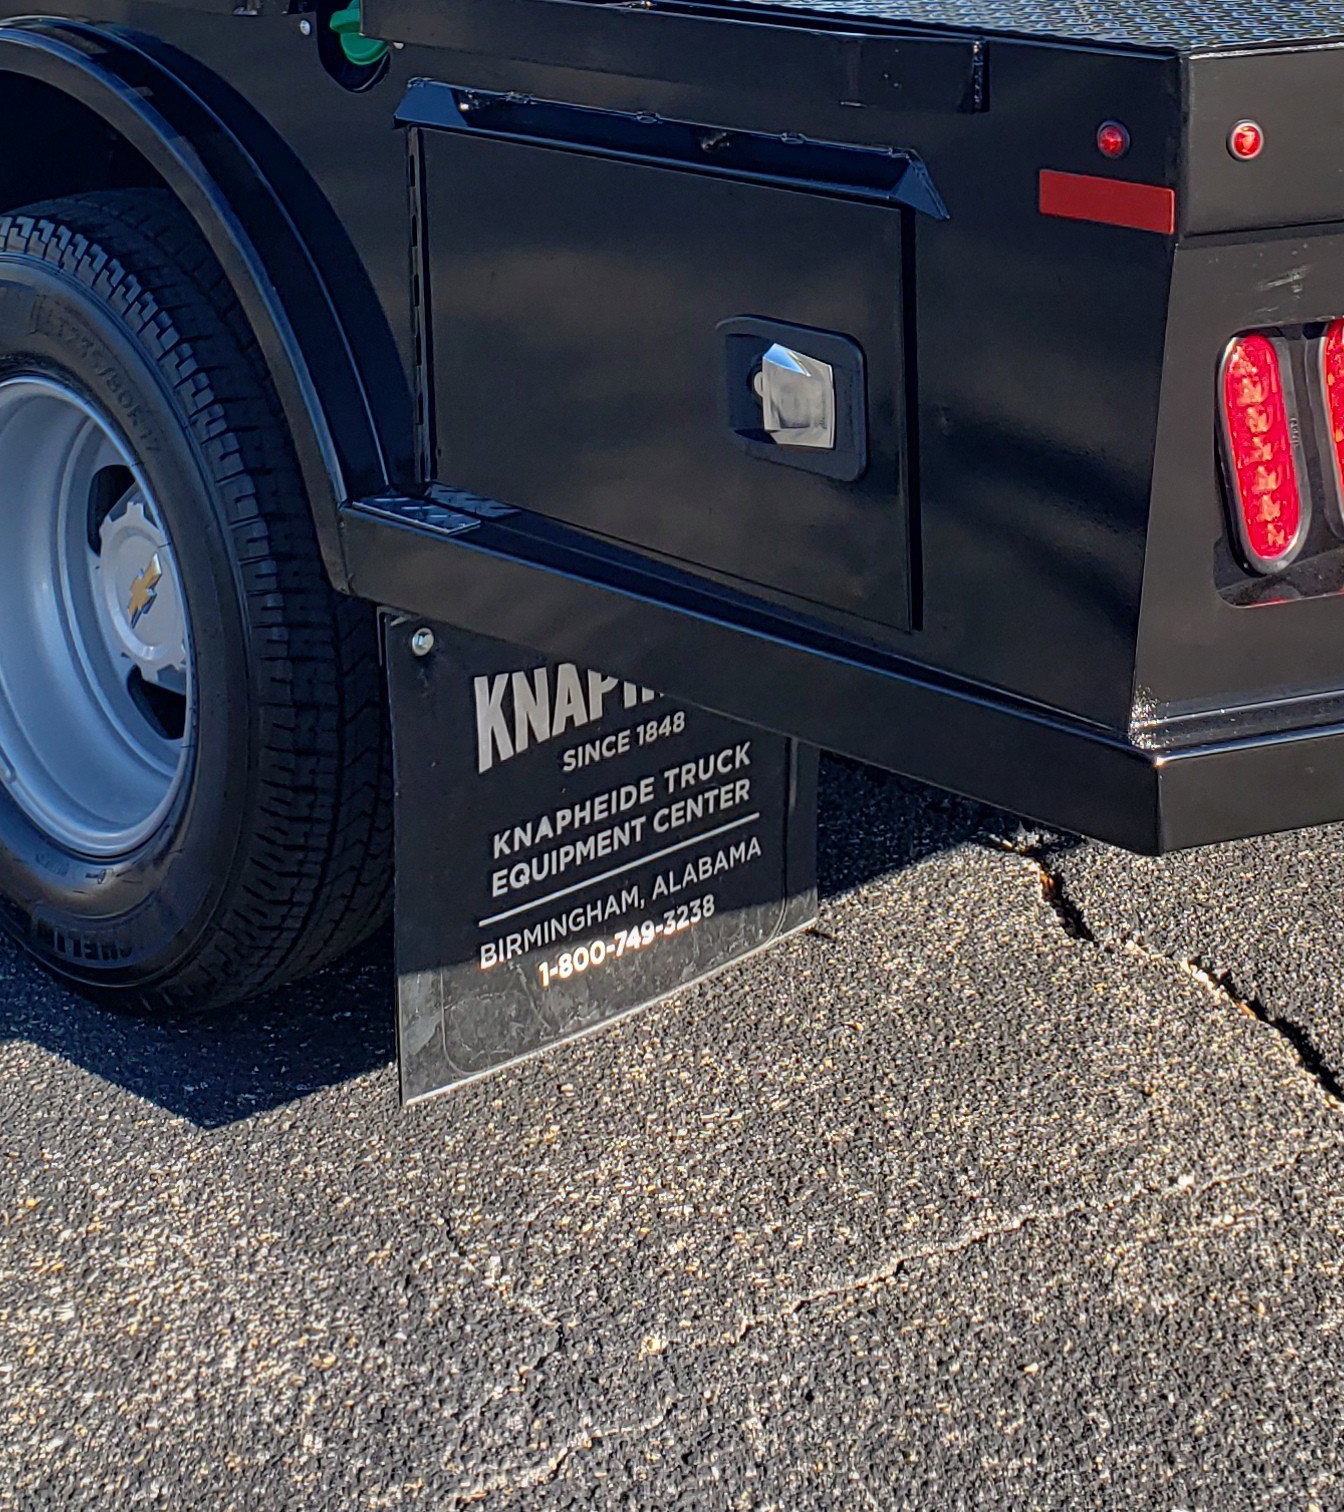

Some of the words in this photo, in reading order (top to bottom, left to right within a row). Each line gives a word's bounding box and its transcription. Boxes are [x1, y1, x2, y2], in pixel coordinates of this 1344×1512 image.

[493, 776, 655, 860] KNAPHEIDE
[664, 740, 752, 794] TRUCK
[562, 729, 631, 772] SINCE
[636, 710, 686, 747] 1848
[491, 815, 647, 898] EQUIPMENT
[653, 778, 751, 834] CENTER
[479, 885, 646, 970] BIRMINGHAM,
[652, 836, 762, 901] ALABAMA
[538, 893, 715, 987] 1-800-749-3238
